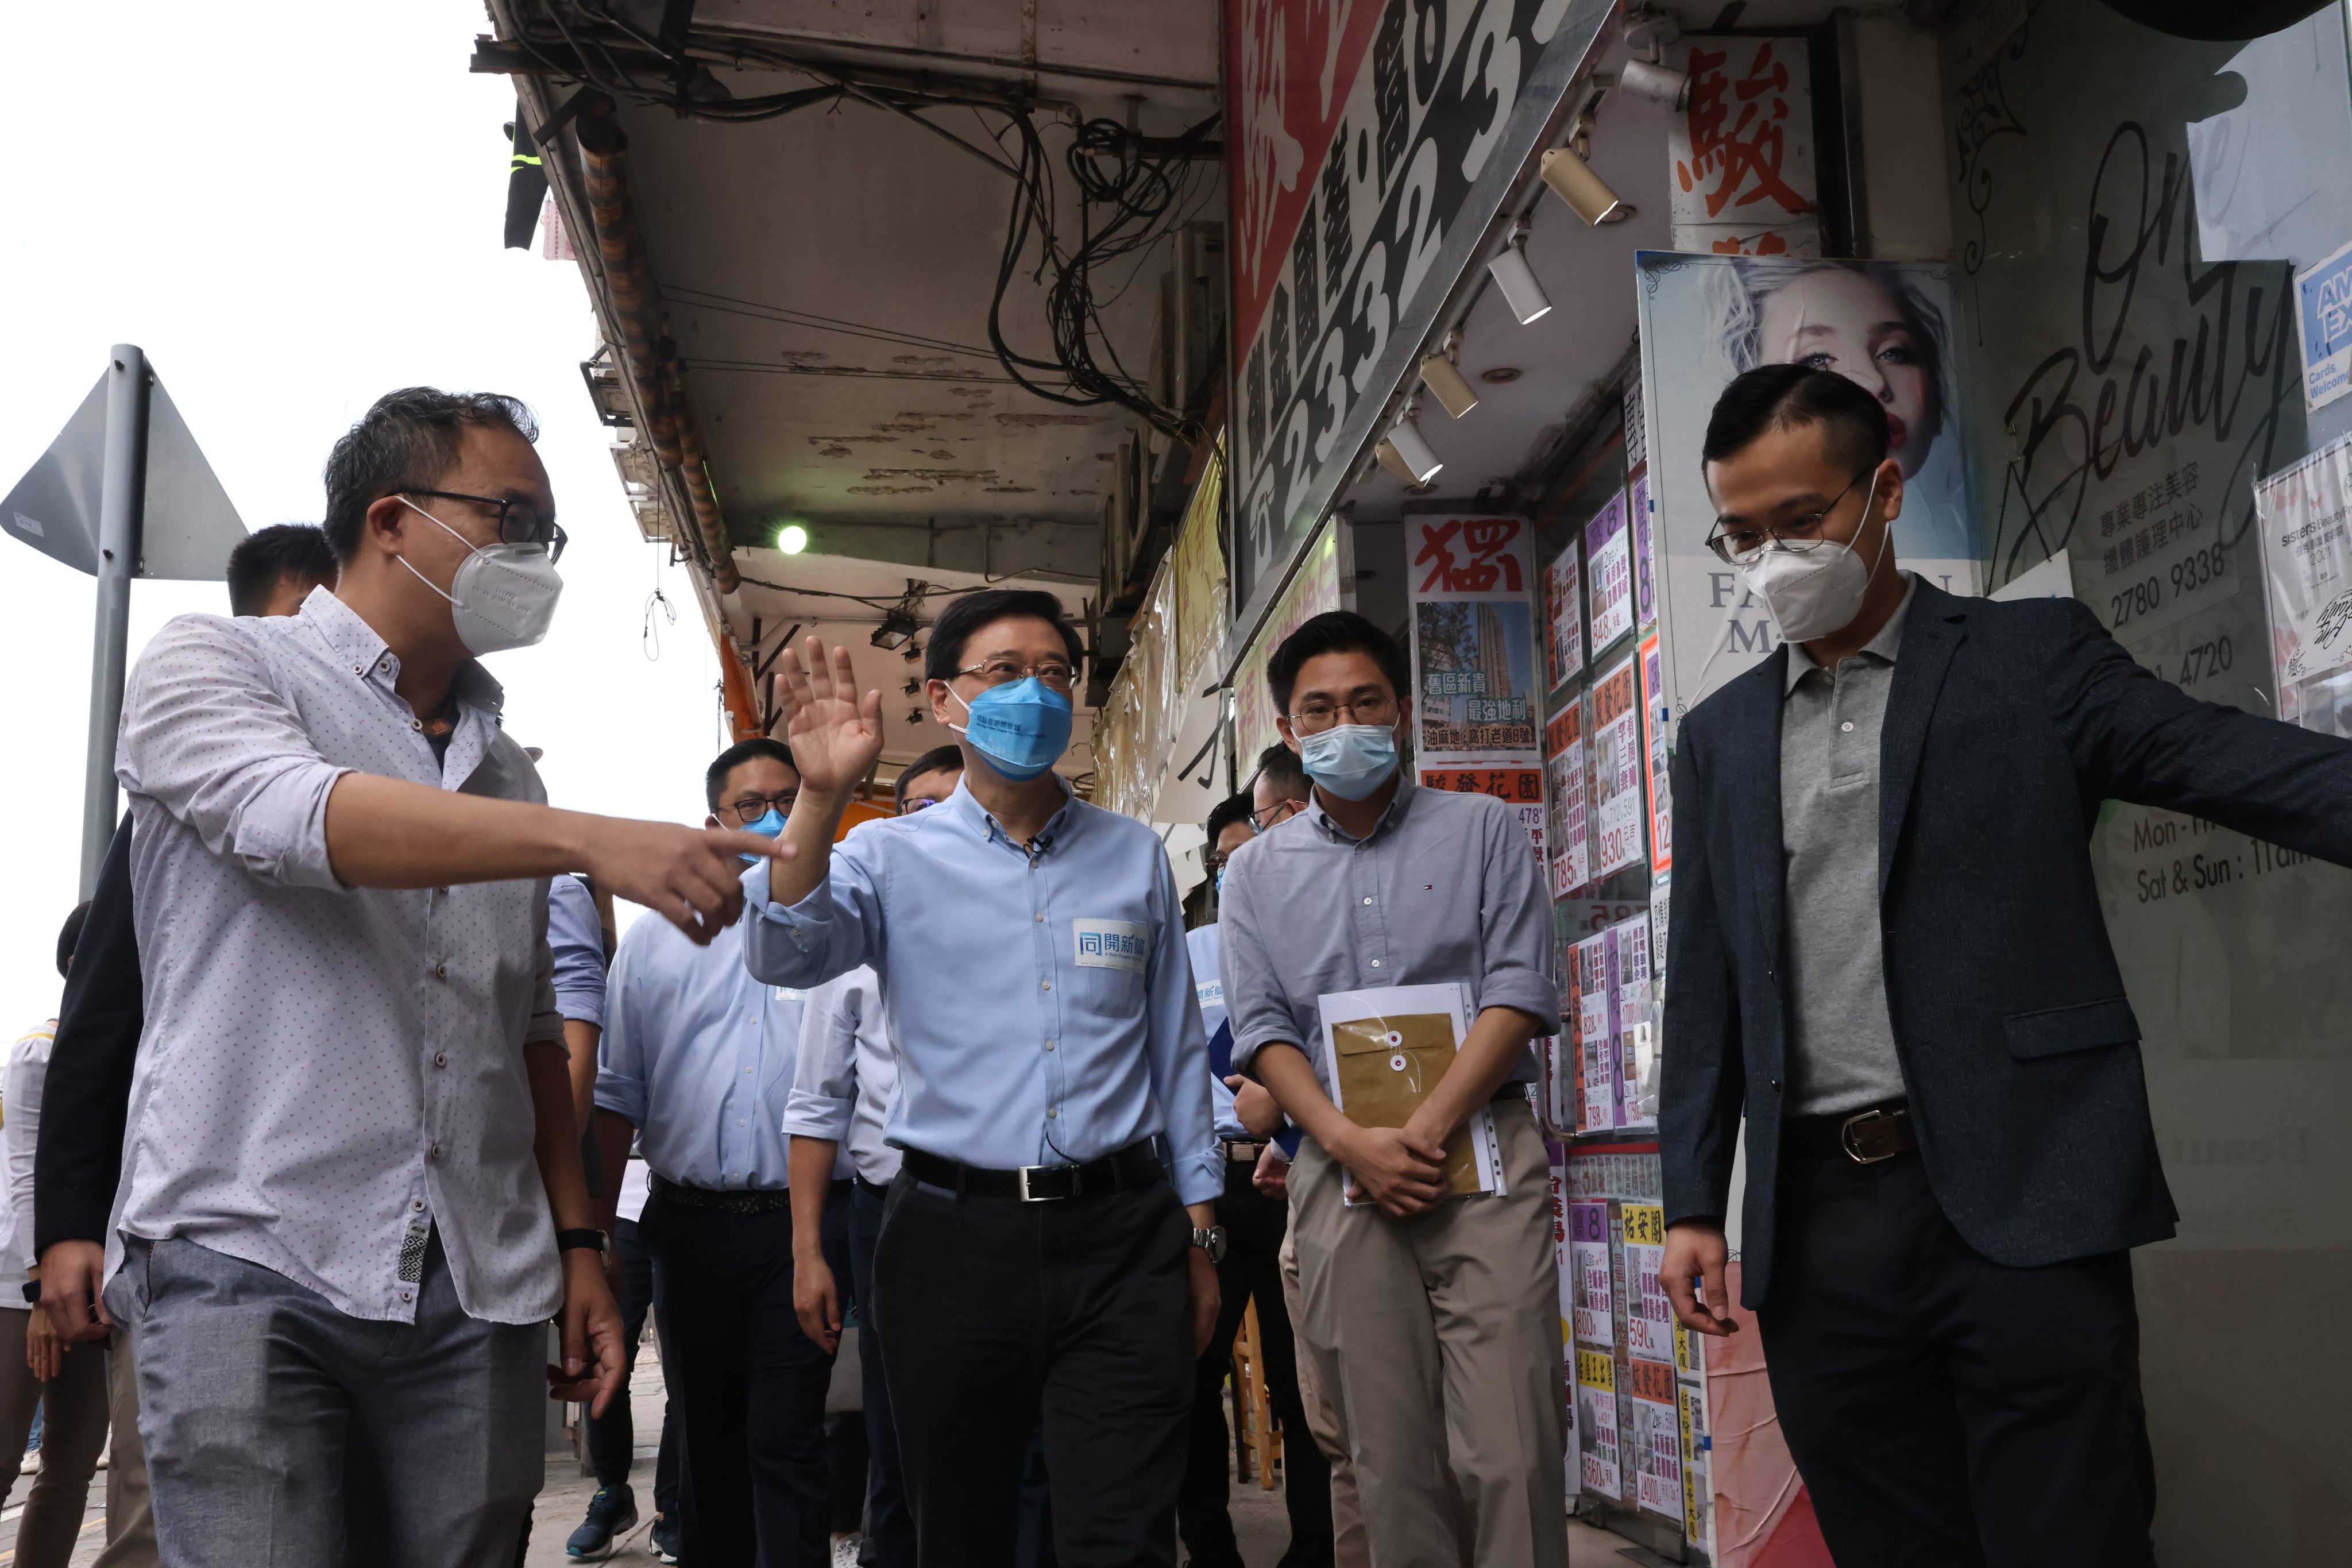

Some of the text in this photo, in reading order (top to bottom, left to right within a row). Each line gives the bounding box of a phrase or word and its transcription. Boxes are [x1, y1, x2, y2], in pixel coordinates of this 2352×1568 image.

[2309, 362, 2336, 384] Cards
[2100, 461, 2198, 538] 專業專注美容
[2103, 504, 2203, 576] 纖體護理中心
[2111, 542, 2224, 629] 2780 9338
[1427, 672, 1486, 695] 舊區新貴
[2179, 635, 2233, 686] 4720
[1468, 698, 1526, 721] 最強地利
[2134, 816, 2177, 853] Mon
[2137, 869, 2166, 903] Sat
[2193, 853, 2231, 890] Sun
